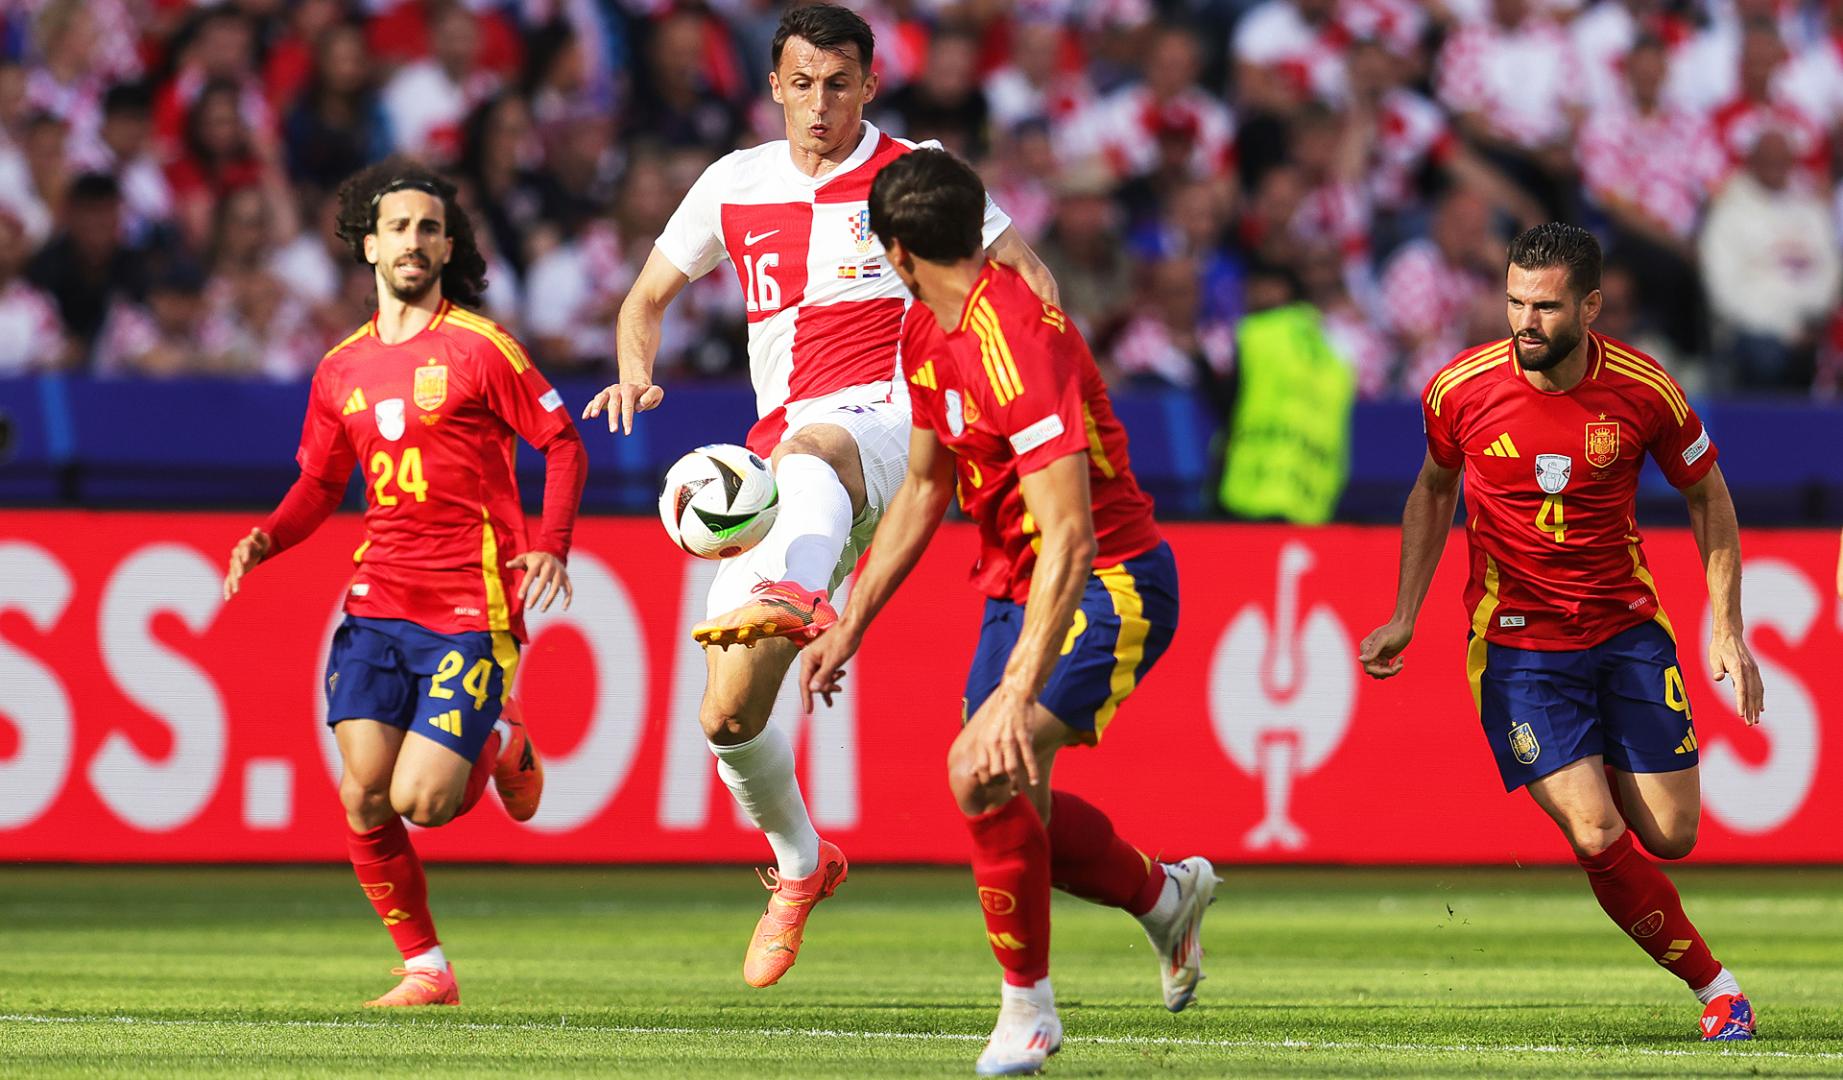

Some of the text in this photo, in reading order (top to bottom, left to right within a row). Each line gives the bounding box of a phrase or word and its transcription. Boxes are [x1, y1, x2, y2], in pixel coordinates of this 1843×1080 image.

[743, 253, 781, 312] 16
[370, 447, 428, 506] 24
[1535, 493, 1568, 543] 4
[428, 650, 493, 711] 24
[1697, 558, 1843, 834] S
